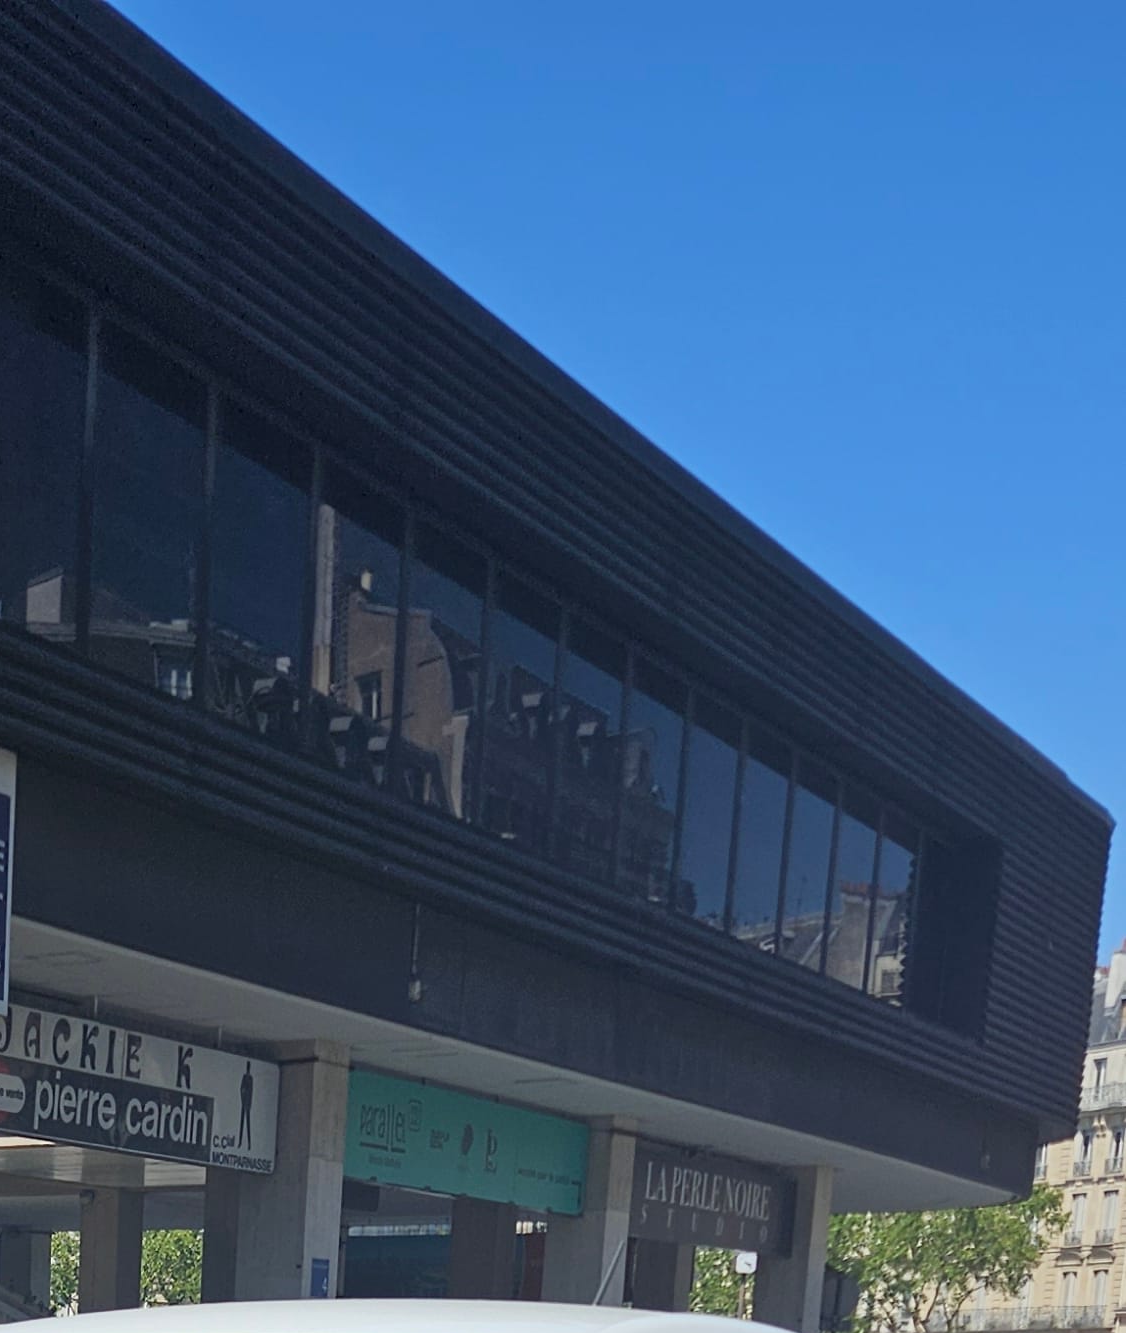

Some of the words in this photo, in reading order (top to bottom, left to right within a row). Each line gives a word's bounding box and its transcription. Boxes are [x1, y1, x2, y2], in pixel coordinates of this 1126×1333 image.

[176, 1045, 193, 1090] K
[34, 1071, 116, 1130] pierre
[126, 1095, 208, 1146] cardin
[212, 1151, 273, 1173] MONTPARNASSE
[645, 1161, 667, 1203] LA
[670, 1167, 723, 1212] PERLE
[723, 1176, 772, 1221] NOIRE
[640, 1203, 768, 1243] STUDIO
